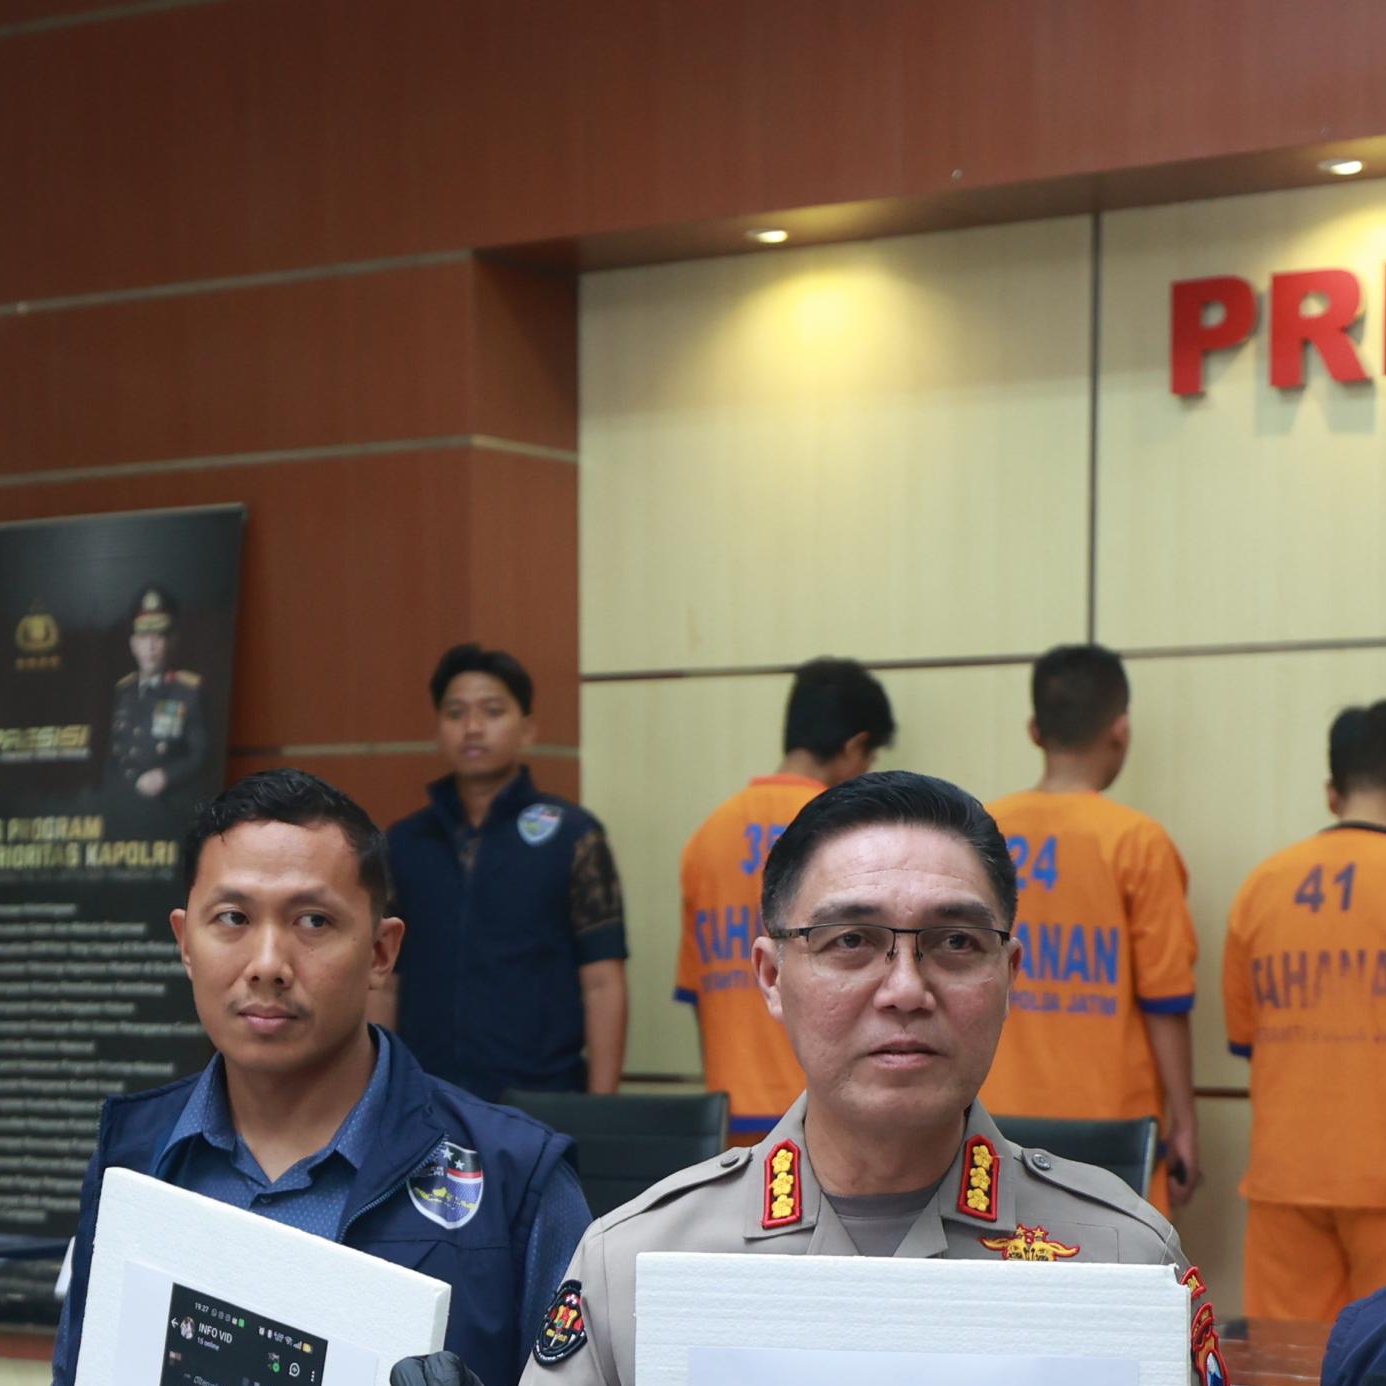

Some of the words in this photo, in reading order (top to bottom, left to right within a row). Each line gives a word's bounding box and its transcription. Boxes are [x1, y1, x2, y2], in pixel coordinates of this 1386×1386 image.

[7, 814, 104, 841] PROGRAM
[85, 840, 178, 867] KAPOLRI
[1006, 835, 1058, 891] 24
[1295, 862, 1356, 913] 41
[198, 1322, 218, 1339] INFO
[219, 1329, 233, 1344] VID
